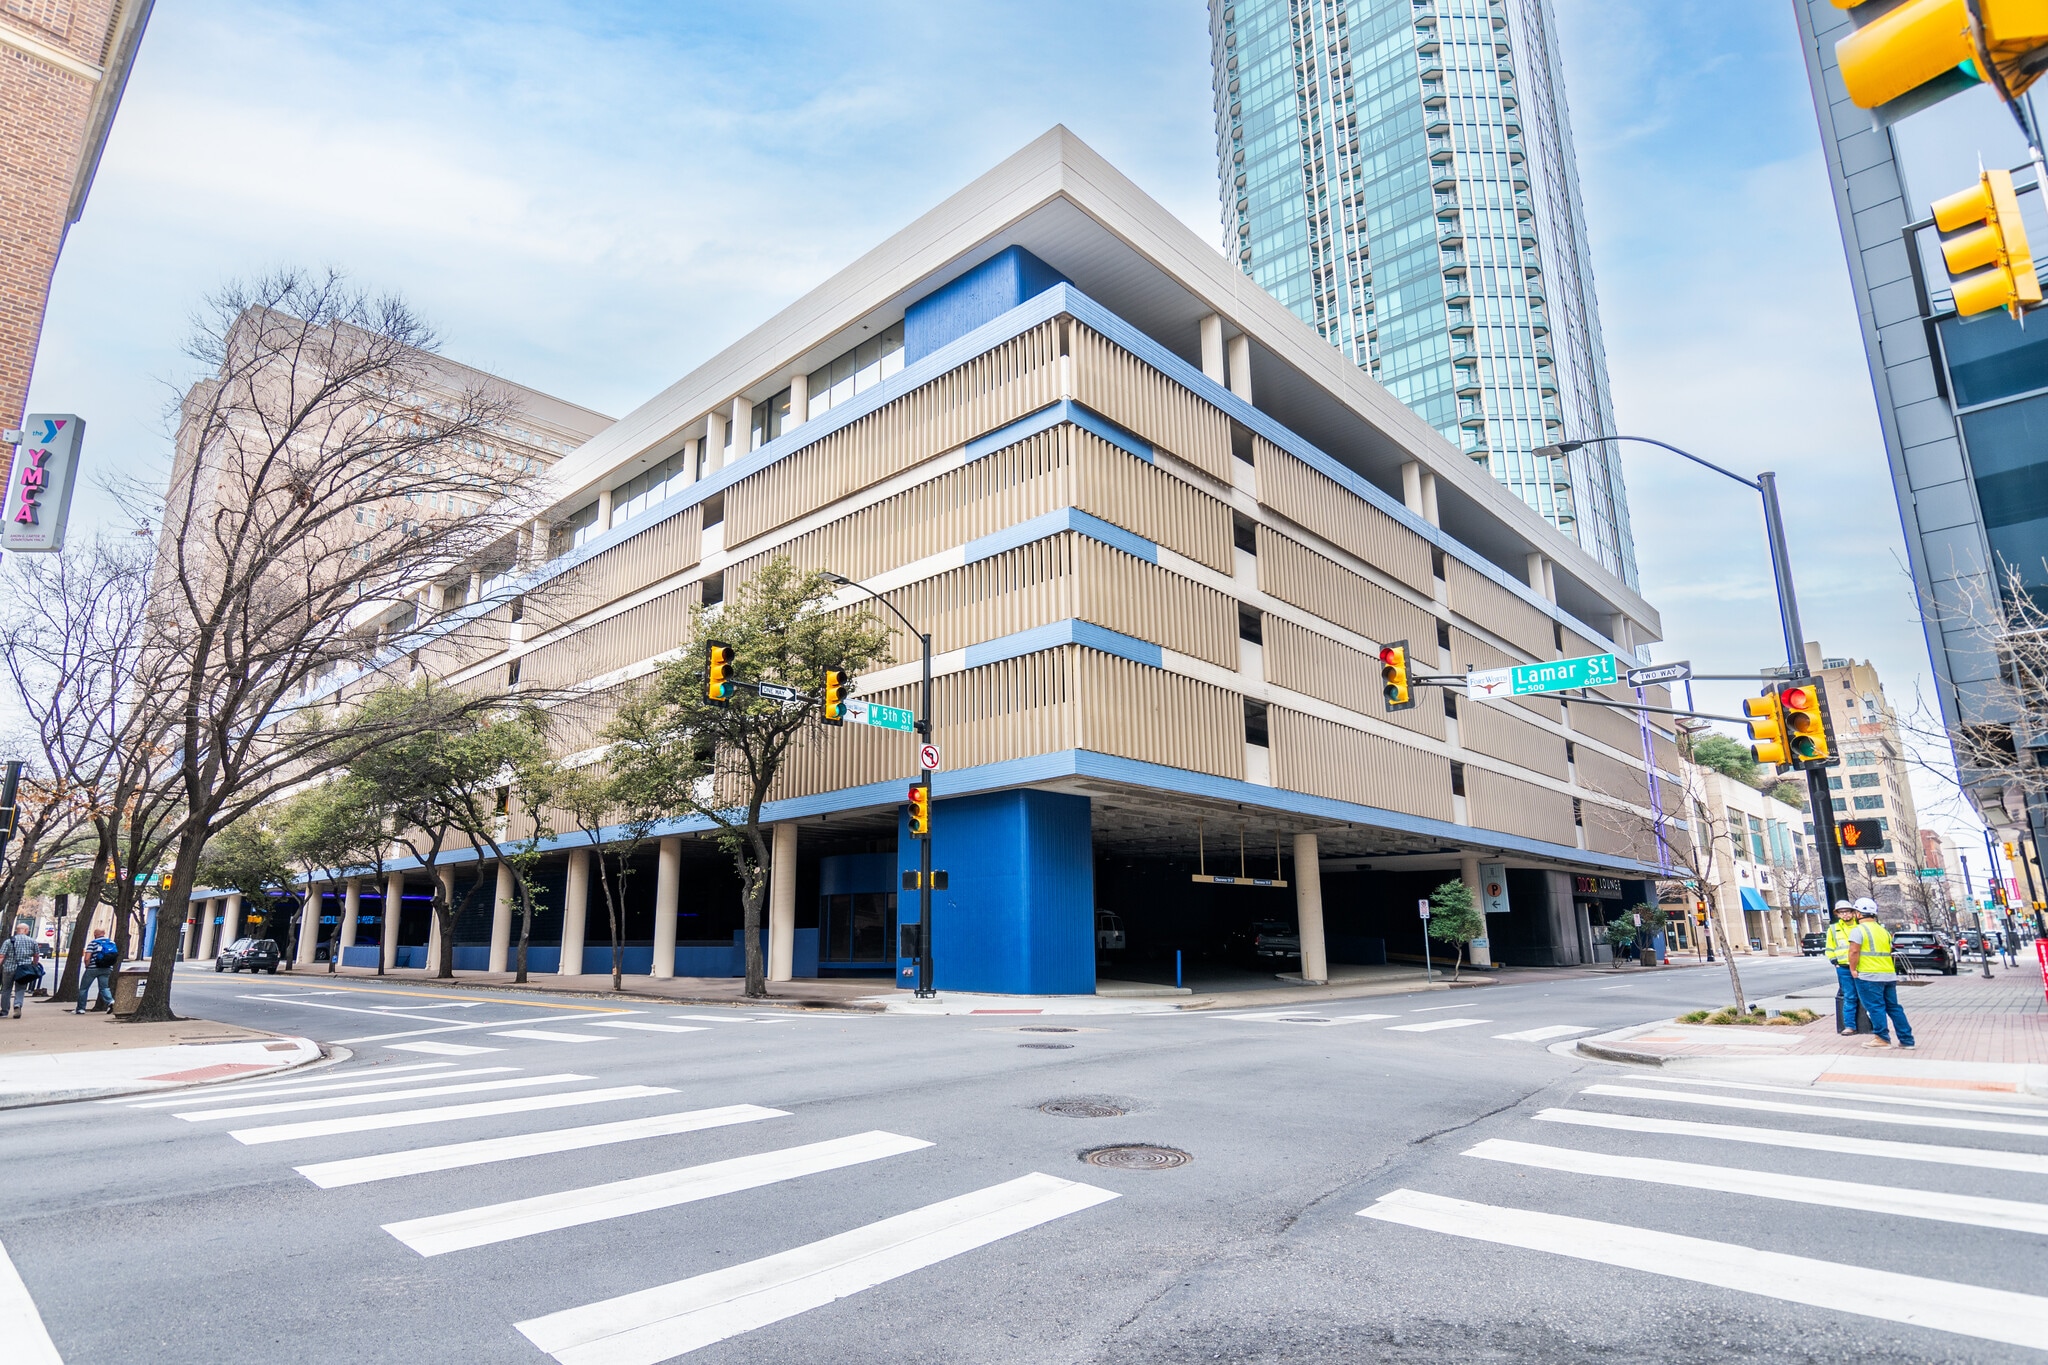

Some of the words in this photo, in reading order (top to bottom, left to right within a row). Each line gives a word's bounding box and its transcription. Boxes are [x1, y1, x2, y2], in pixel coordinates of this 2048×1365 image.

[14, 448, 52, 525] YMCA
[1517, 663, 1577, 684] Lamar
[1587, 656, 1609, 675] St
[1641, 672, 1657, 680] TWO
[1660, 669, 1677, 677] WAY
[1527, 684, 1545, 692] 500
[1584, 676, 1601, 685] 600
[871, 705, 879, 719] W
[882, 707, 898, 722] 5th
[901, 711, 912, 725] St
[1491, 884, 1498, 896] P
[1599, 878, 1621, 891] LOUNGE
